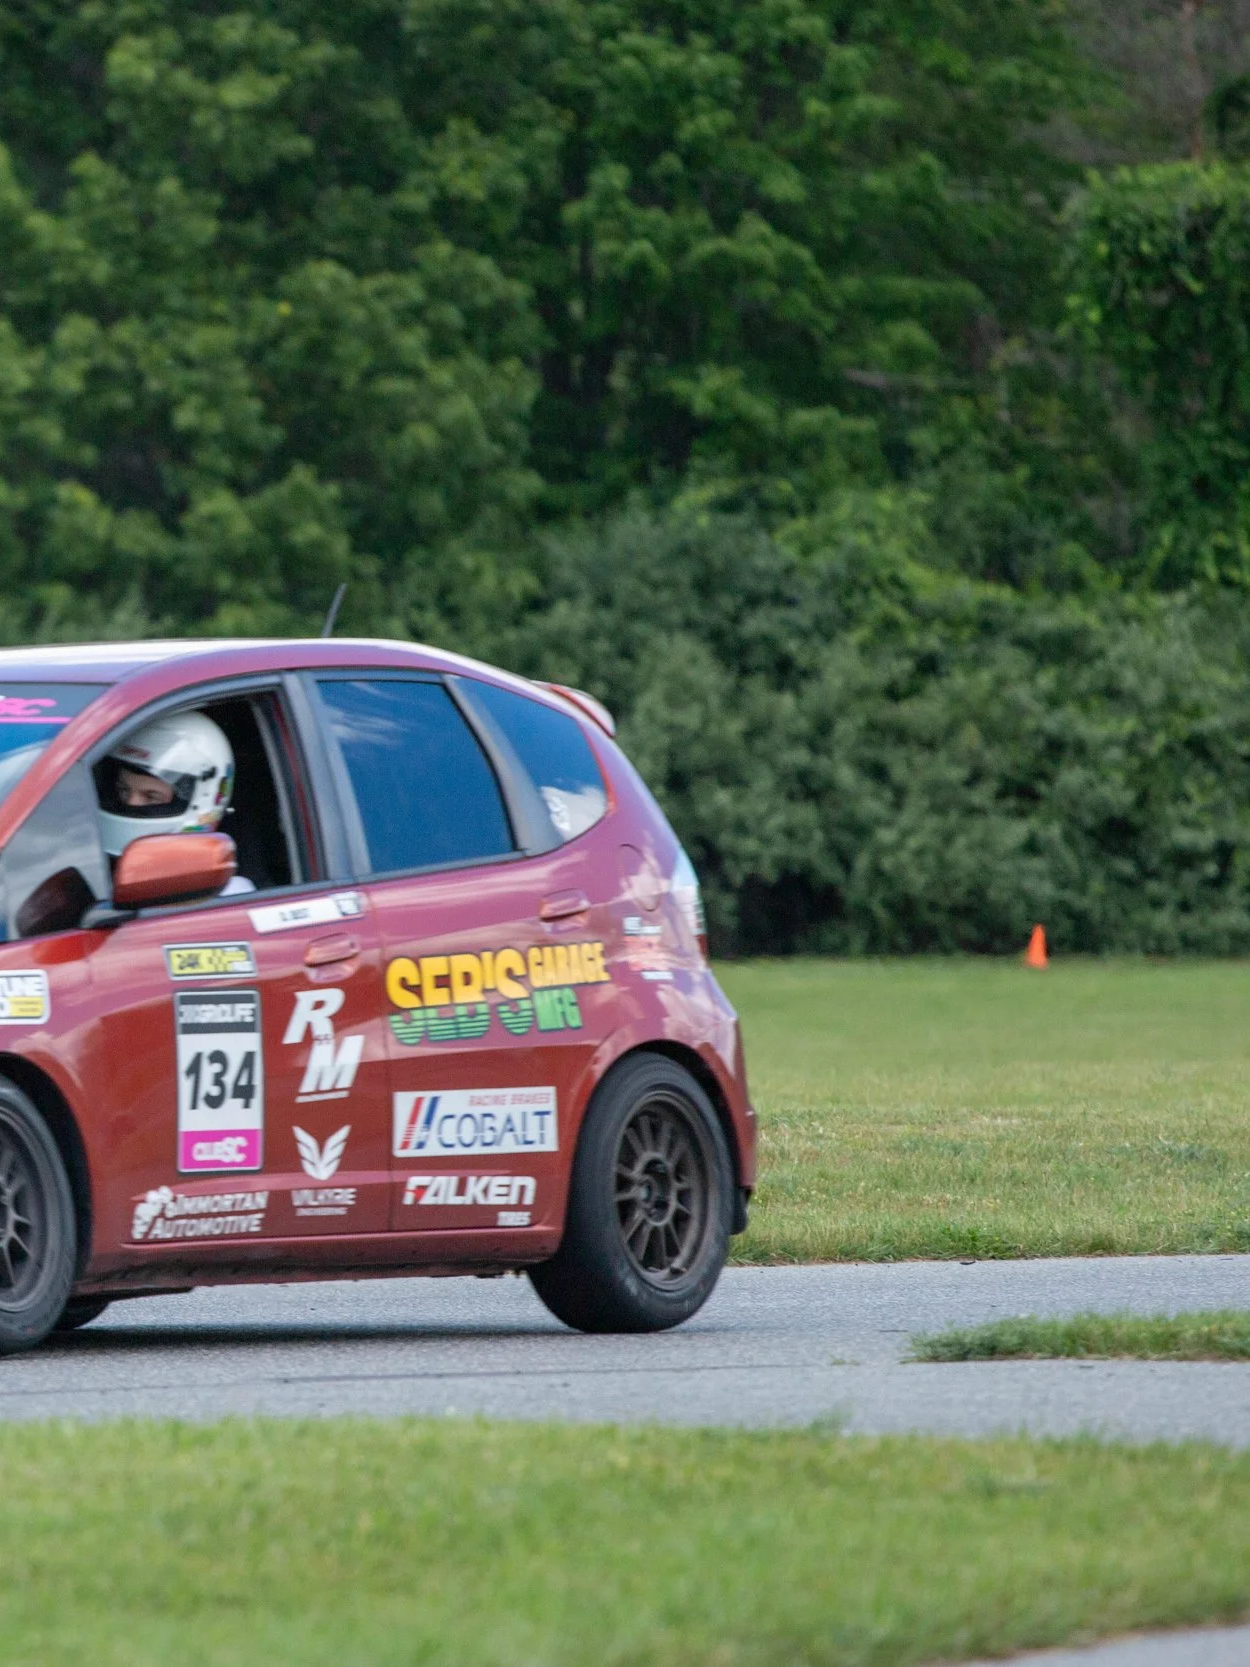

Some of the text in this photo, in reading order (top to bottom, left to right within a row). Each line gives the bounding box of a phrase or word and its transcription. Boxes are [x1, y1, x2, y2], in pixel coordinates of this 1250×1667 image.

[281, 987, 346, 1045] R
[385, 941, 611, 1046] SEB'S GARAGE
[531, 986, 583, 1033] MFG
[184, 1049, 257, 1110] 134
[297, 1034, 366, 1094] M
[469, 1092, 551, 1107] RACING BRAKES
[437, 1111, 552, 1149] COBALT
[402, 1175, 537, 1206] FALKEN
[148, 1212, 266, 1240] AUTOMOTIVE
